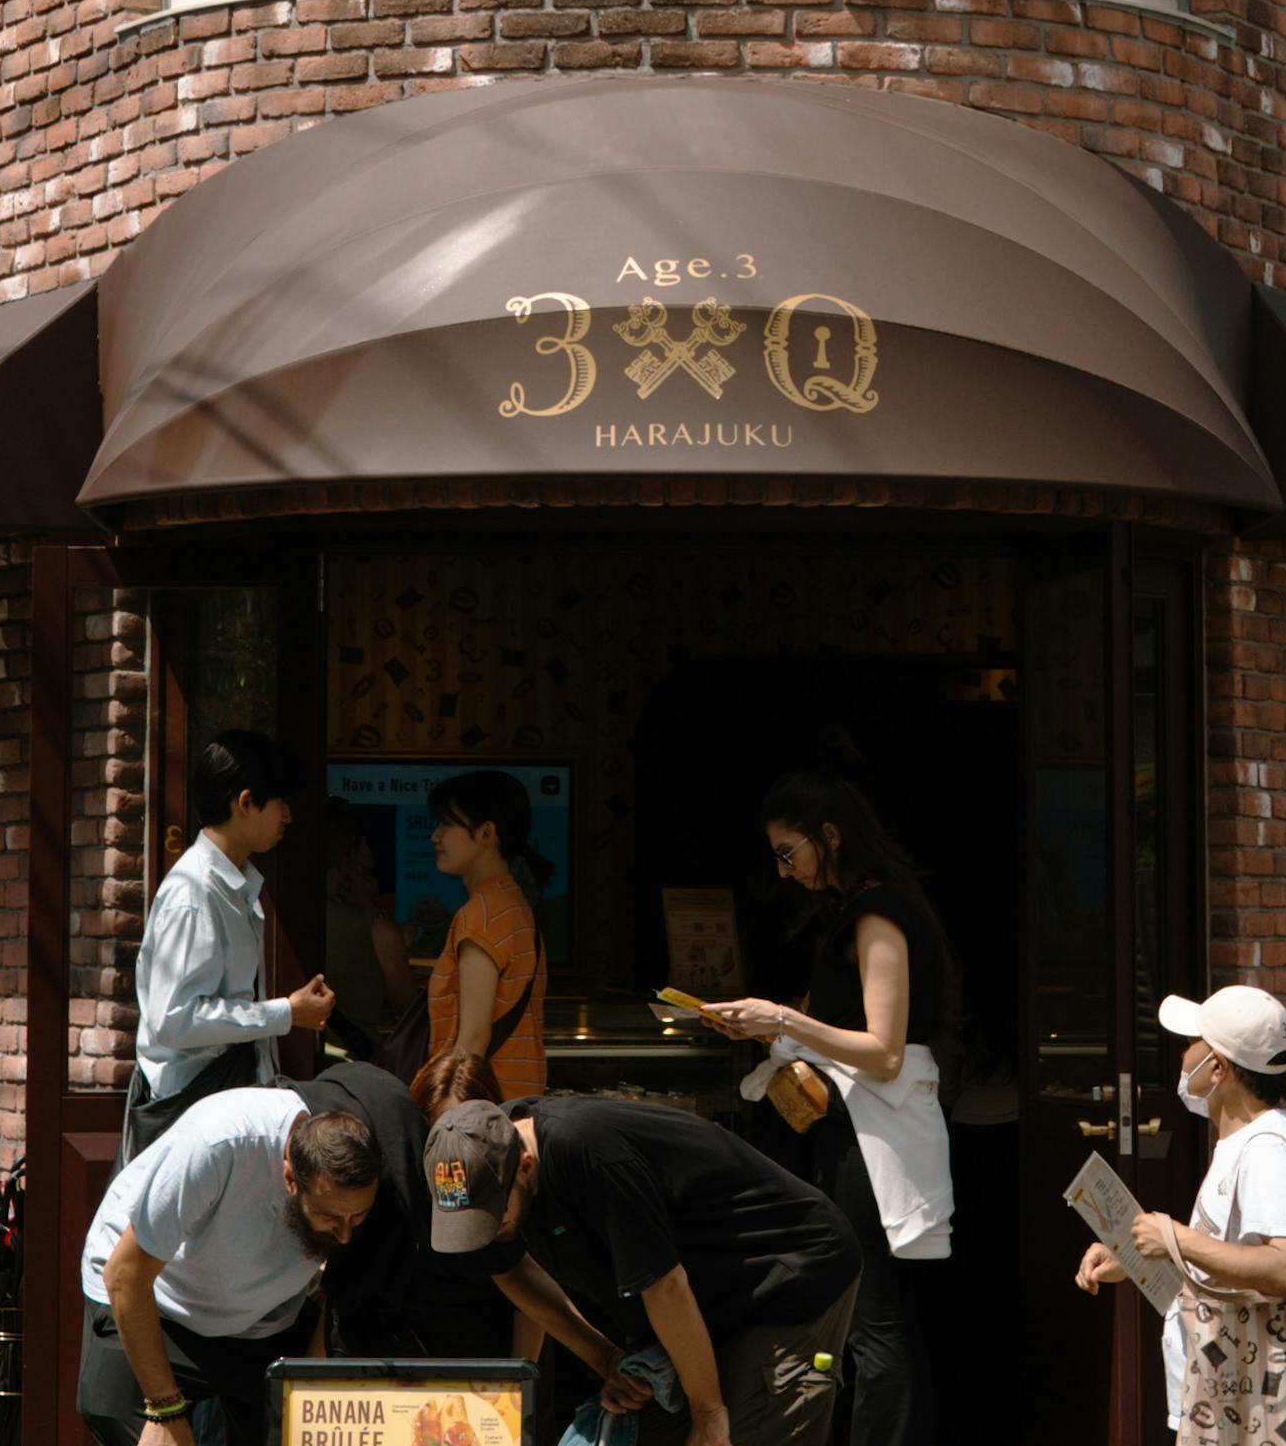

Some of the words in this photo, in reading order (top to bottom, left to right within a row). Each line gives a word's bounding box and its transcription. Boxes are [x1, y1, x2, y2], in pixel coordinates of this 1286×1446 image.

[616, 253, 759, 287] Age.3
[498, 291, 597, 418] 3
[762, 292, 880, 414] Q
[595, 422, 793, 448] HARAJUKU
[342, 777, 374, 792] Have
[378, 781, 386, 792] a
[390, 778, 419, 792] Nice
[302, 1400, 385, 1425] BANANA
